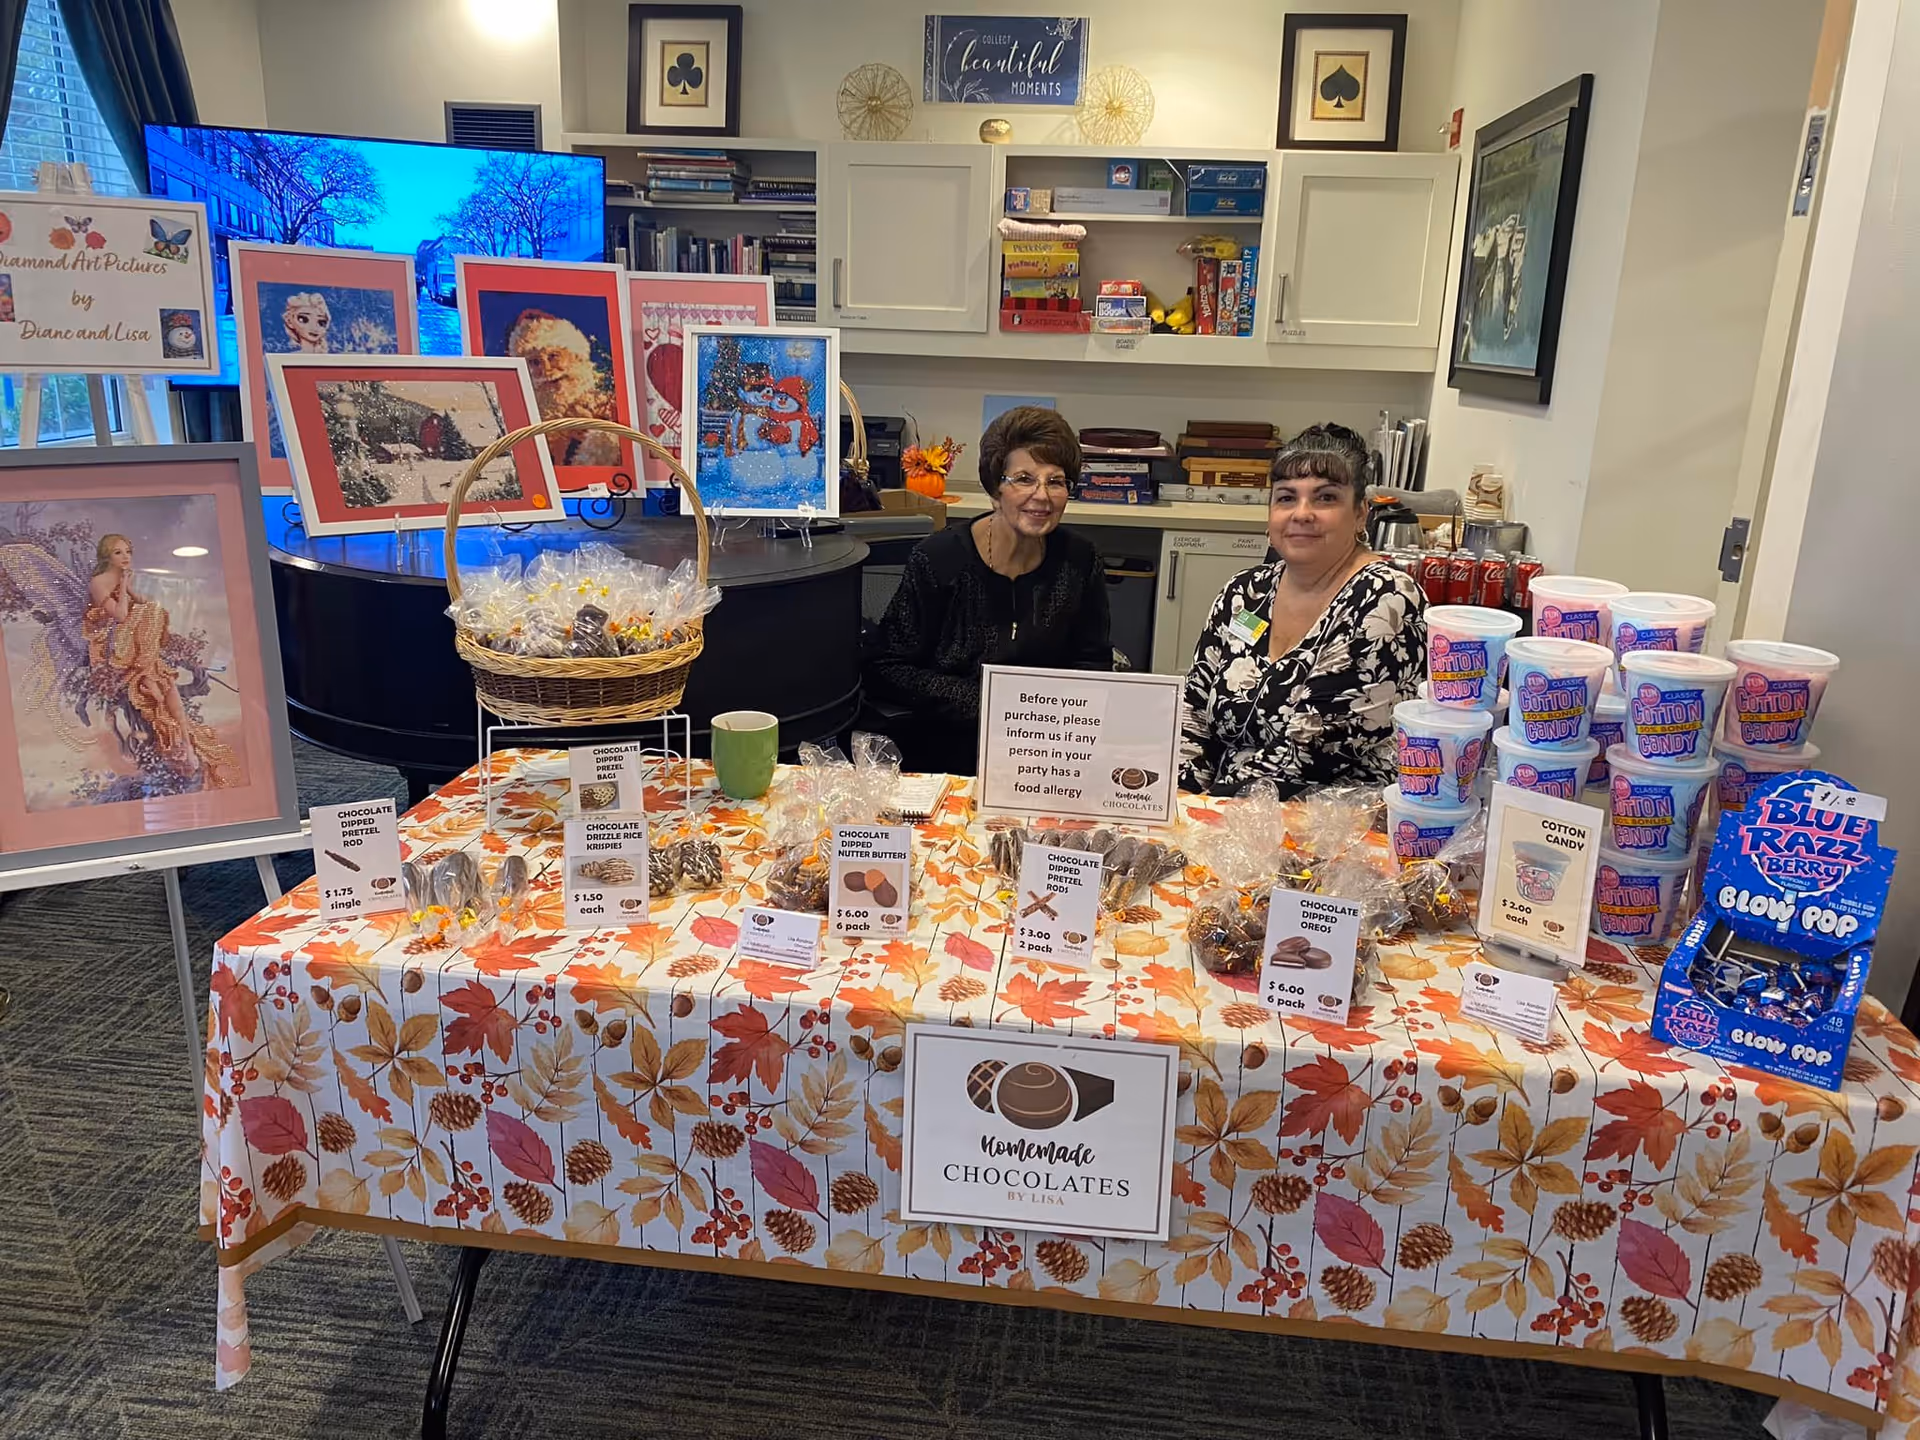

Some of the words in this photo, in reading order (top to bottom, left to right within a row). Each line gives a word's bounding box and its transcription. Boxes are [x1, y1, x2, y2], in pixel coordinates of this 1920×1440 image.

[982, 34, 1011, 45] COLLECT
[960, 40, 1065, 79] beautiful
[1011, 81, 1062, 97] MOMENTS
[0, 250, 70, 271] iamond
[71, 250, 101, 272] Art
[103, 252, 168, 275] Pictures
[1243, 262, 1251, 279] Am
[1240, 281, 1250, 304] Who
[71, 289, 96, 311] by
[1200, 285, 1212, 318] Yahtzee
[18, 319, 75, 341] Diane
[76, 321, 112, 341] and
[114, 321, 152, 342] Lisa
[1565, 612, 1595, 621] CLASSIC
[1537, 618, 1598, 640] COTTON
[1640, 629, 1673, 638] CLASSIC
[1453, 643, 1483, 651] CLASSIC
[1430, 648, 1485, 672] COTTON
[1552, 678, 1583, 688] CLASSIC
[1772, 682, 1806, 690] CLASSIC
[1019, 692, 1058, 705] Before
[1061, 697, 1088, 708] your
[1519, 687, 1586, 712] COTTON
[1664, 691, 1699, 700] CLASSIC
[1735, 688, 1808, 713] COTTON
[1004, 710, 1060, 725] purchase,
[1063, 713, 1101, 726] please
[1526, 712, 1545, 721] 50%
[1547, 708, 1583, 719] BONUS
[1632, 699, 1701, 725] COTTON
[1765, 711, 1804, 721] BONUS
[1661, 722, 1698, 732] BONUS
[1006, 727, 1045, 740] inform
[1048, 732, 1061, 742] us
[1064, 730, 1073, 743] if
[1075, 734, 1097, 746] any
[1409, 738, 1436, 746] CLASSIC
[593, 745, 638, 755] CHOCOLATE
[1008, 746, 1048, 758] person
[1051, 747, 1062, 759] in
[1065, 751, 1092, 762] your
[596, 755, 624, 764] DIPPED
[596, 764, 624, 772] PREZEL
[1017, 764, 1048, 777] party
[1051, 765, 1071, 778] has
[1073, 770, 1081, 778] a
[597, 773, 616, 781] BAGS
[1542, 770, 1573, 780] CLASSIC
[1014, 781, 1041, 795] food
[1043, 784, 1083, 799] allergy
[1634, 786, 1667, 795] CLASSIC
[337, 805, 393, 819] CHOCOLATE
[1102, 799, 1164, 812] CHOCOLATES
[341, 818, 375, 828] DIPPED
[1764, 798, 1869, 840] BLUE
[342, 827, 380, 838] PRETZEL
[586, 822, 639, 831] CHOCOLATE
[1541, 819, 1586, 839] COTTON
[586, 832, 622, 841] DRIZZLE
[623, 832, 643, 840] RICE
[839, 830, 889, 840] CHOCOLATE
[343, 838, 363, 848] ROD
[586, 842, 622, 850] KRISPIES
[841, 840, 873, 849] DIPPED
[1545, 833, 1585, 852] CANDY
[1745, 826, 1870, 864] RAZZ
[838, 850, 870, 859] NUTTER
[872, 851, 907, 860] BUTTERS
[1047, 853, 1100, 869] CHOCOLATE
[1048, 863, 1081, 876] DIPPED
[1047, 873, 1083, 887] PRETZEL
[333, 887, 353, 897] 1.75
[1046, 883, 1069, 894] RODS
[582, 893, 603, 902] 1.50
[330, 899, 361, 910] single
[580, 904, 604, 914] each
[1299, 899, 1359, 917] CHOCOLATE
[1509, 900, 1532, 915] 2.00
[1828, 901, 1849, 912] FILLED
[1847, 906, 1876, 919] LOLLIPOP
[846, 910, 869, 918] 6.00
[1301, 910, 1338, 924] DIPPED
[1719, 886, 1797, 922] BLOW
[1801, 905, 1859, 938] POP
[1505, 912, 1529, 927] each
[836, 922, 843, 930] 6
[845, 922, 870, 932] pack
[1300, 921, 1332, 934] OREOS
[1028, 929, 1051, 941] 3.00
[1019, 940, 1026, 949] 2
[1027, 943, 1053, 954] pack
[1278, 983, 1305, 996] 6.00
[1267, 995, 1274, 1004] 6
[1277, 998, 1305, 1010] pack
[1676, 1005, 1720, 1028] BLUE
[1828, 1016, 1844, 1028] 48
[1667, 1017, 1719, 1038] RAZZ
[1822, 1023, 1846, 1035] COUNT
[1731, 1028, 1787, 1055] BLOW
[1791, 1043, 1833, 1067] POP
[980, 1134, 1096, 1167] Homemade
[943, 1163, 1131, 1198] CHOCOLATES
[1007, 1191, 1027, 1203] BY
[1031, 1193, 1065, 1206] LISA
